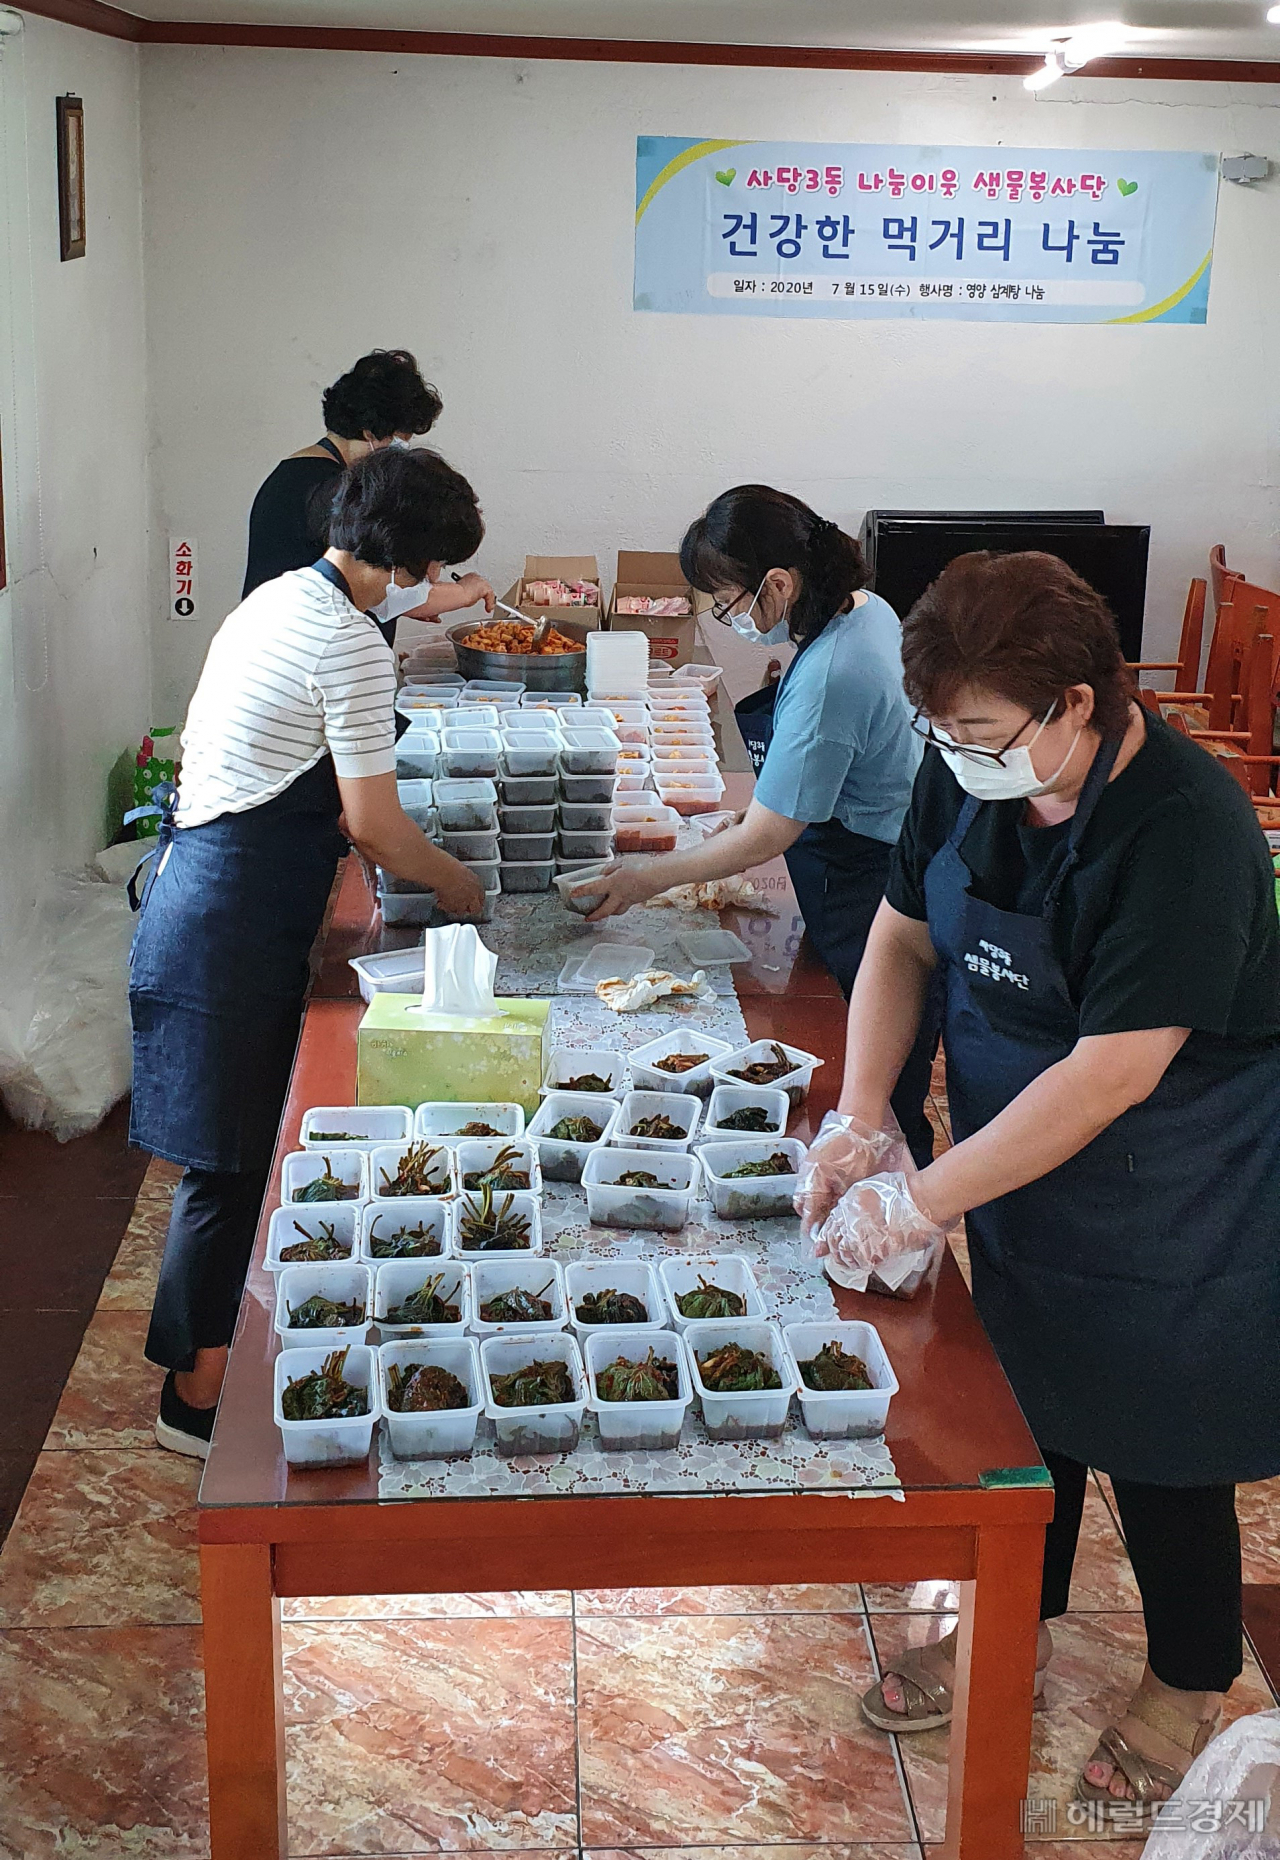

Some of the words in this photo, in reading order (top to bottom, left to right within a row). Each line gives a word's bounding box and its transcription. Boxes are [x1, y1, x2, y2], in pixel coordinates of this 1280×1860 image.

[746, 166, 842, 195] 사당3동
[858, 168, 957, 197] 나눔이웃
[973, 170, 1106, 200] 샘물봉사단
[721, 212, 855, 260] 건강한
[883, 216, 1012, 262] 먹거리
[1042, 220, 1126, 265] 나눔
[733, 279, 757, 293] 일자
[770, 281, 814, 295] 2020년
[919, 283, 954, 298] 행사명
[966, 283, 987, 299] 영양
[990, 284, 1021, 300] 삼계탕
[1025, 285, 1046, 300] 나눔
[175, 542, 193, 595] 소화기
